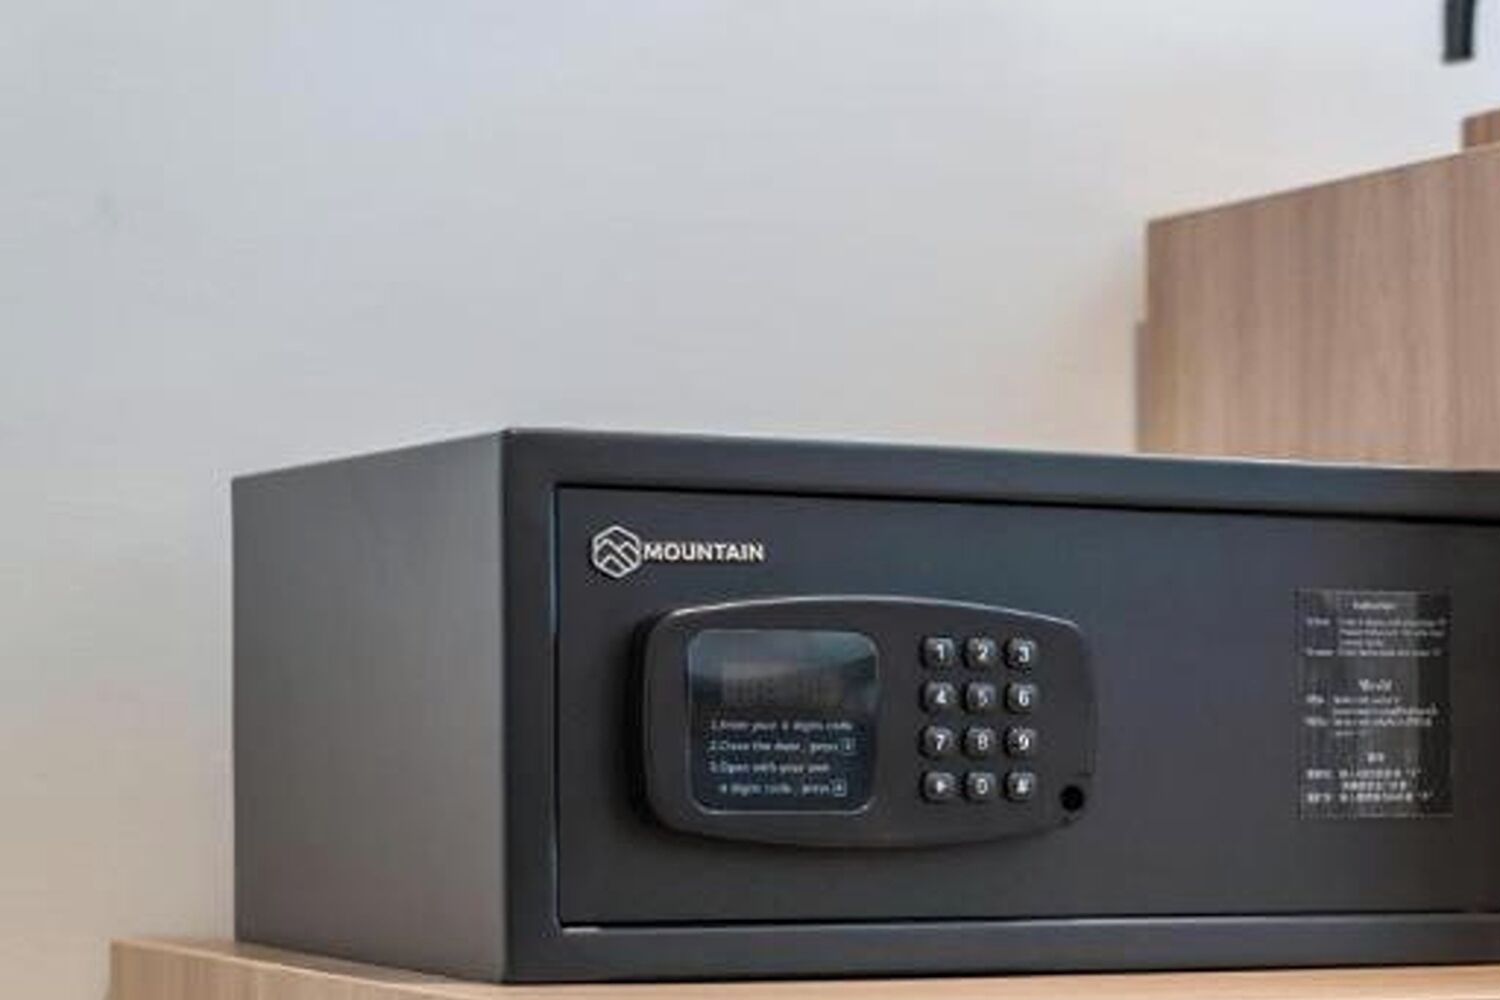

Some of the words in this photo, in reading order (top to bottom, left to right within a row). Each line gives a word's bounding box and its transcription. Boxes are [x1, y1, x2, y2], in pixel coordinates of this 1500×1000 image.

[643, 542, 764, 561] MOUNTAIN
[936, 643, 945, 659] 1
[977, 644, 988, 660] 2
[1018, 646, 1029, 662] 3
[936, 690, 947, 704] 4
[978, 689, 988, 706] 5
[1018, 690, 1029, 707] 6
[936, 734, 945, 751] 7
[978, 734, 988, 750] 8
[1018, 734, 1029, 750] 9
[976, 778, 988, 795] 0
